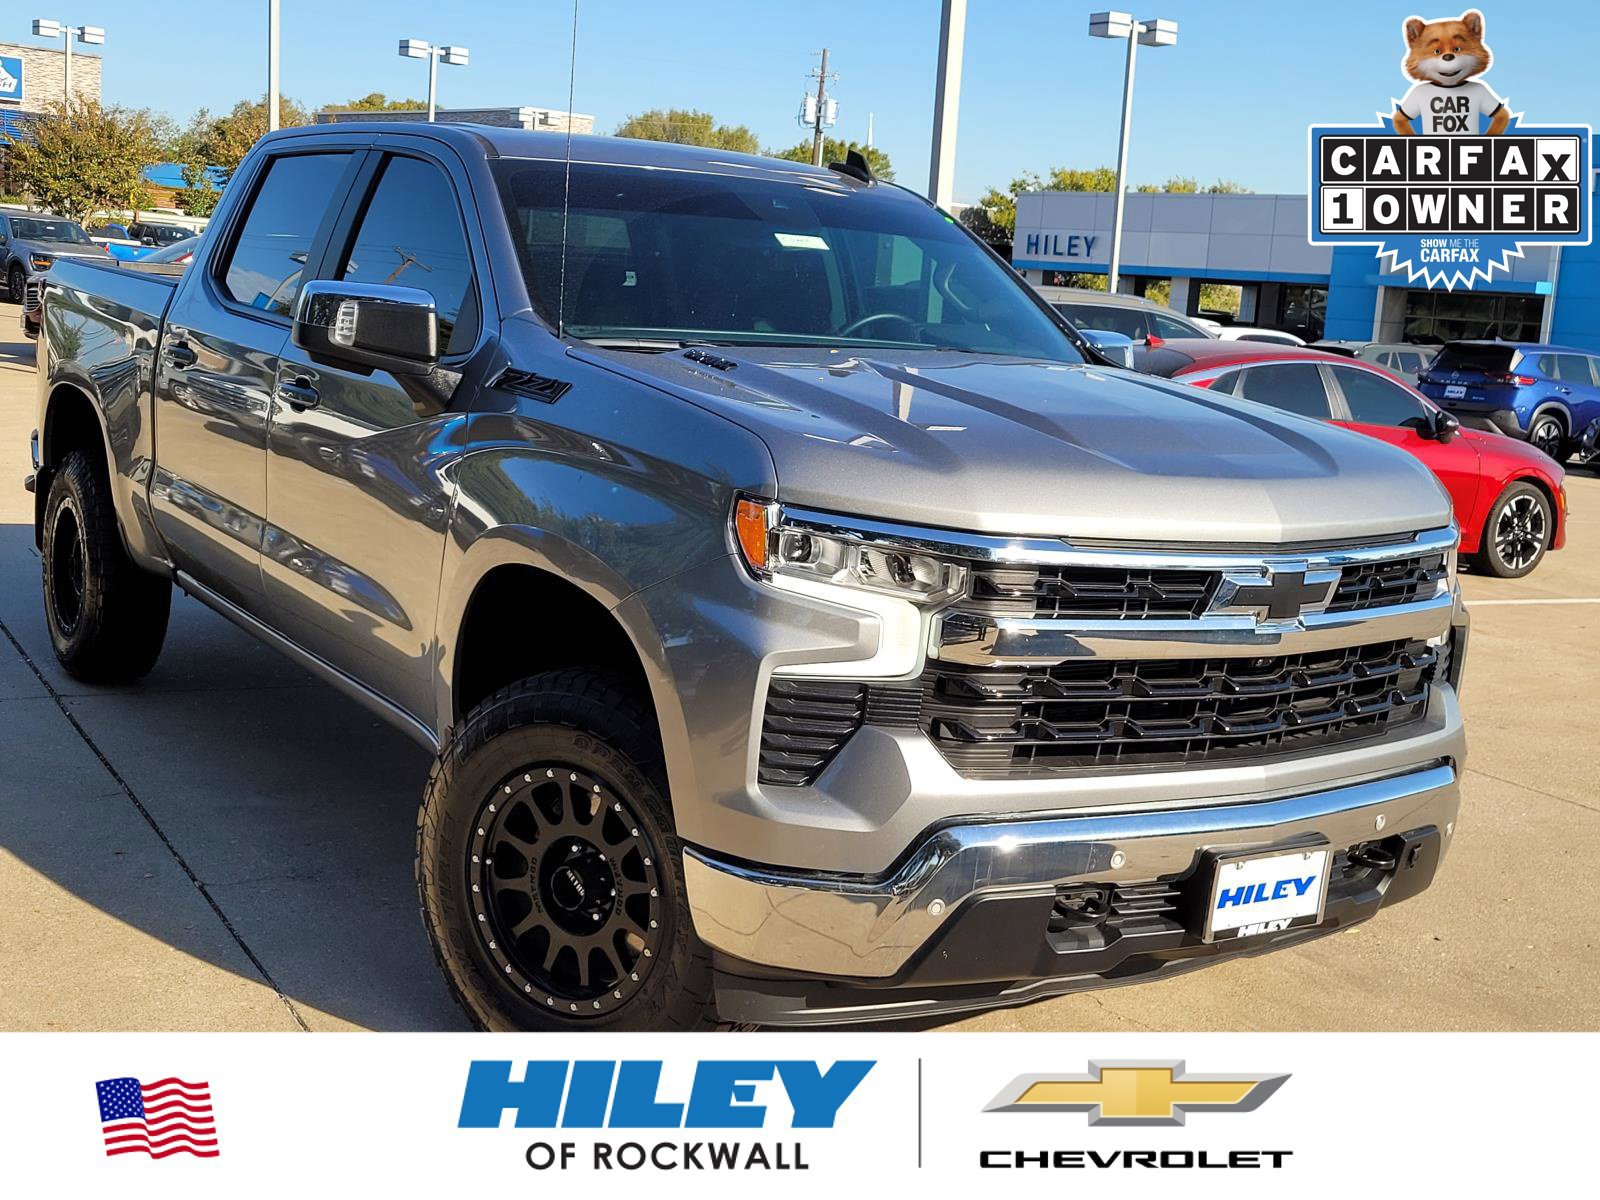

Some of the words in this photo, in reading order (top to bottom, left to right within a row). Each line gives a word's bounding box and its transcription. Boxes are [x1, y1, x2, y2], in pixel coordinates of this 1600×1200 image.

[1026, 233, 1097, 257] HILEY
[1216, 875, 1317, 909] HILEY
[1237, 917, 1293, 938] HILEY
